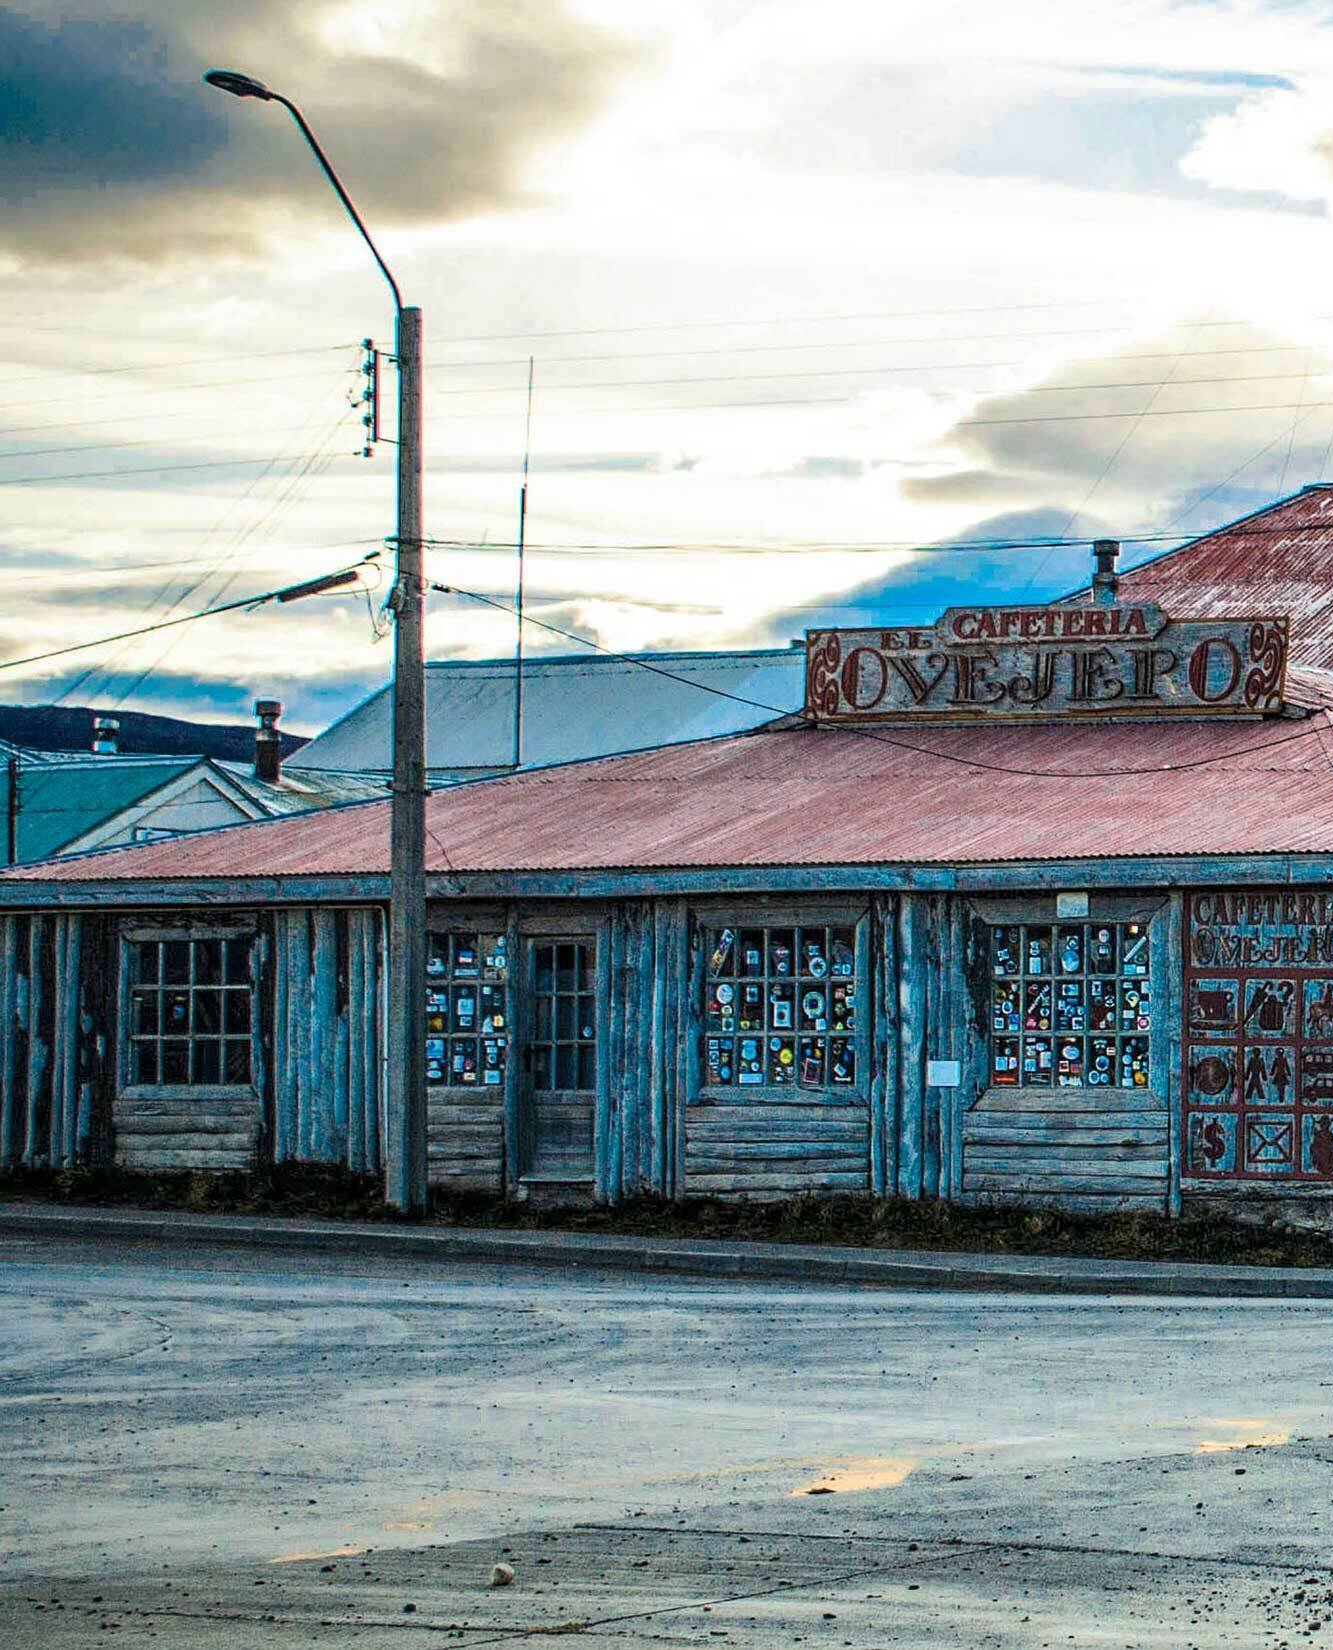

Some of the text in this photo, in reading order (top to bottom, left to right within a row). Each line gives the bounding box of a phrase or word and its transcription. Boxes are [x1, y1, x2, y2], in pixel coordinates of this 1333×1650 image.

[951, 608, 1148, 639] CAFETERIA
[880, 631, 933, 650] EL
[841, 636, 1243, 711] OVEJERO
